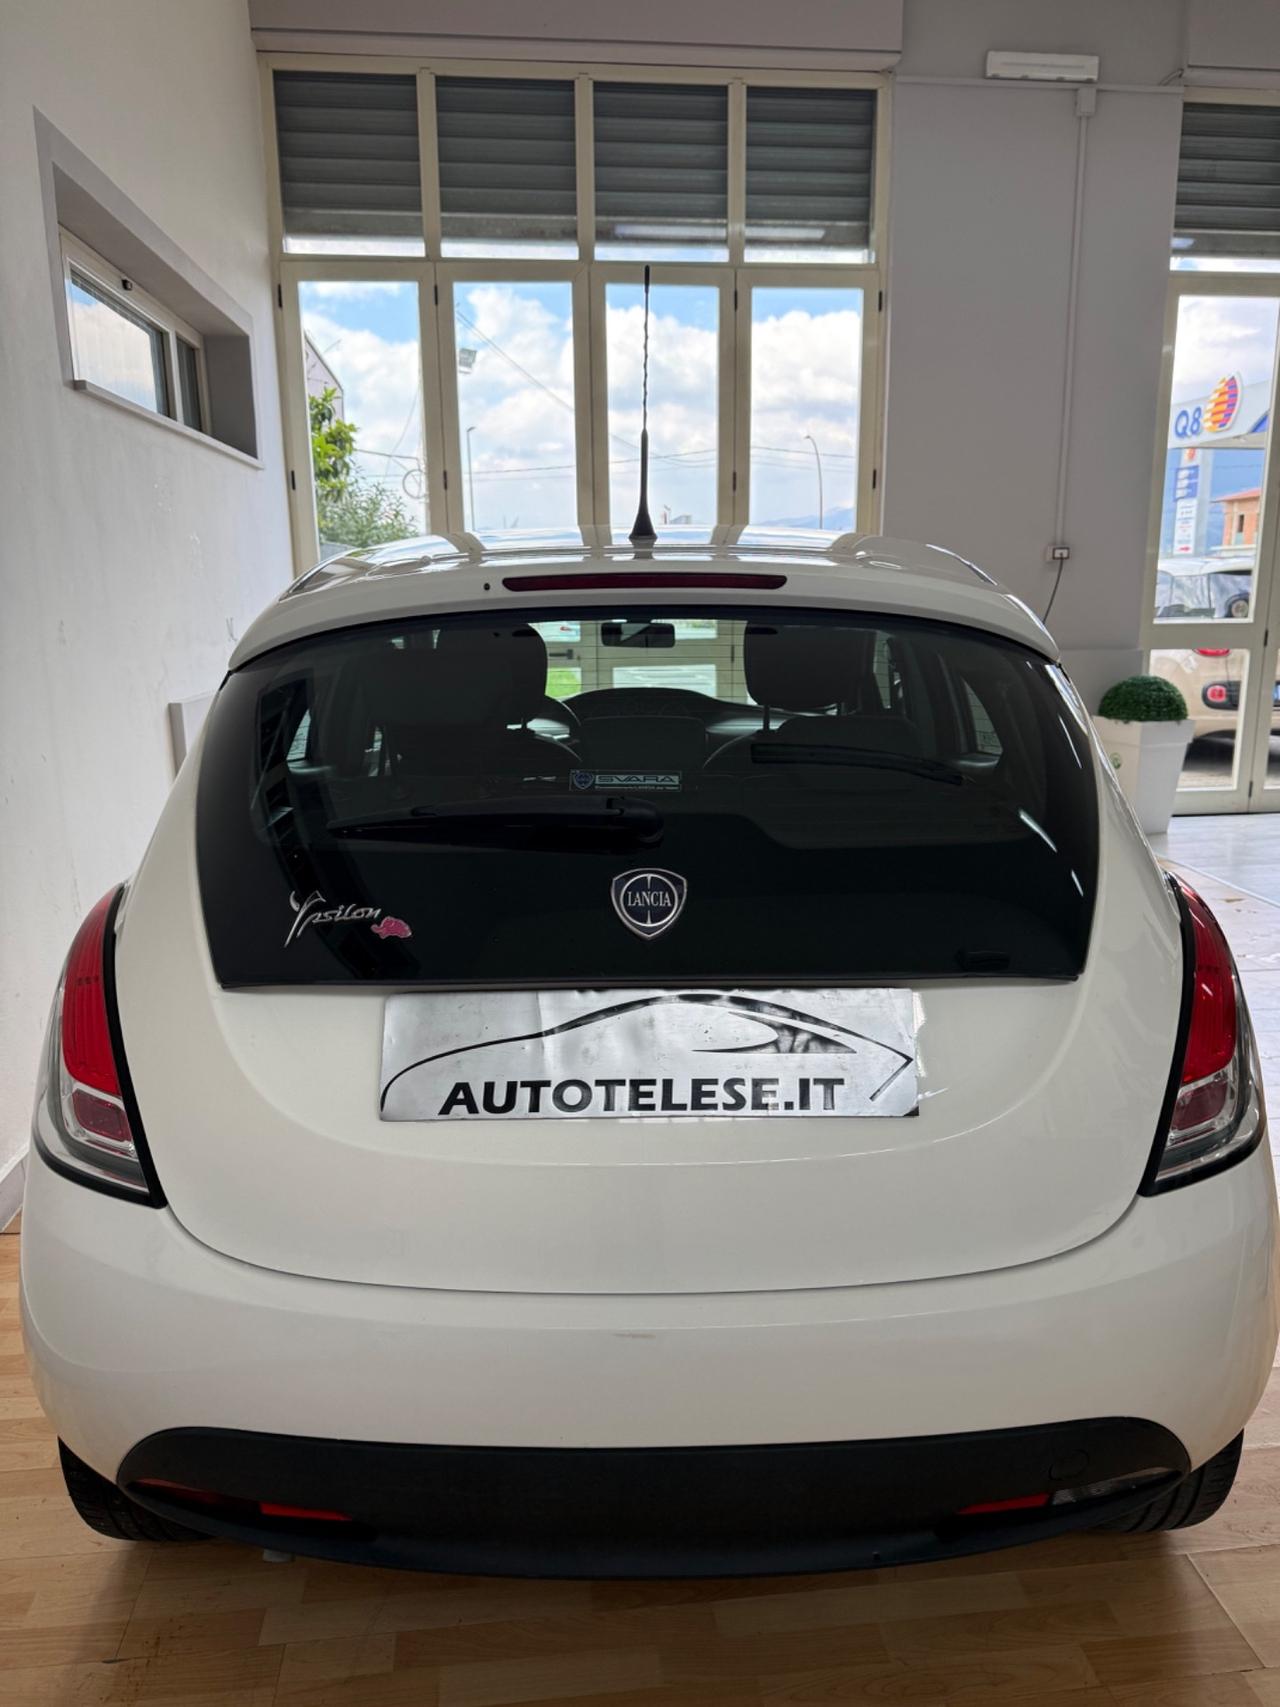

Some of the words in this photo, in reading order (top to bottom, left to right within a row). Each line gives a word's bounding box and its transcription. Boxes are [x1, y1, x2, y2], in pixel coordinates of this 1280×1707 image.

[1175, 407, 1202, 439] Q8
[596, 775, 677, 784] SVARA
[627, 891, 672, 907] LANCIA
[284, 890, 381, 948] Ypsilon
[438, 1078, 845, 1116] AUTOTELESE.IT
